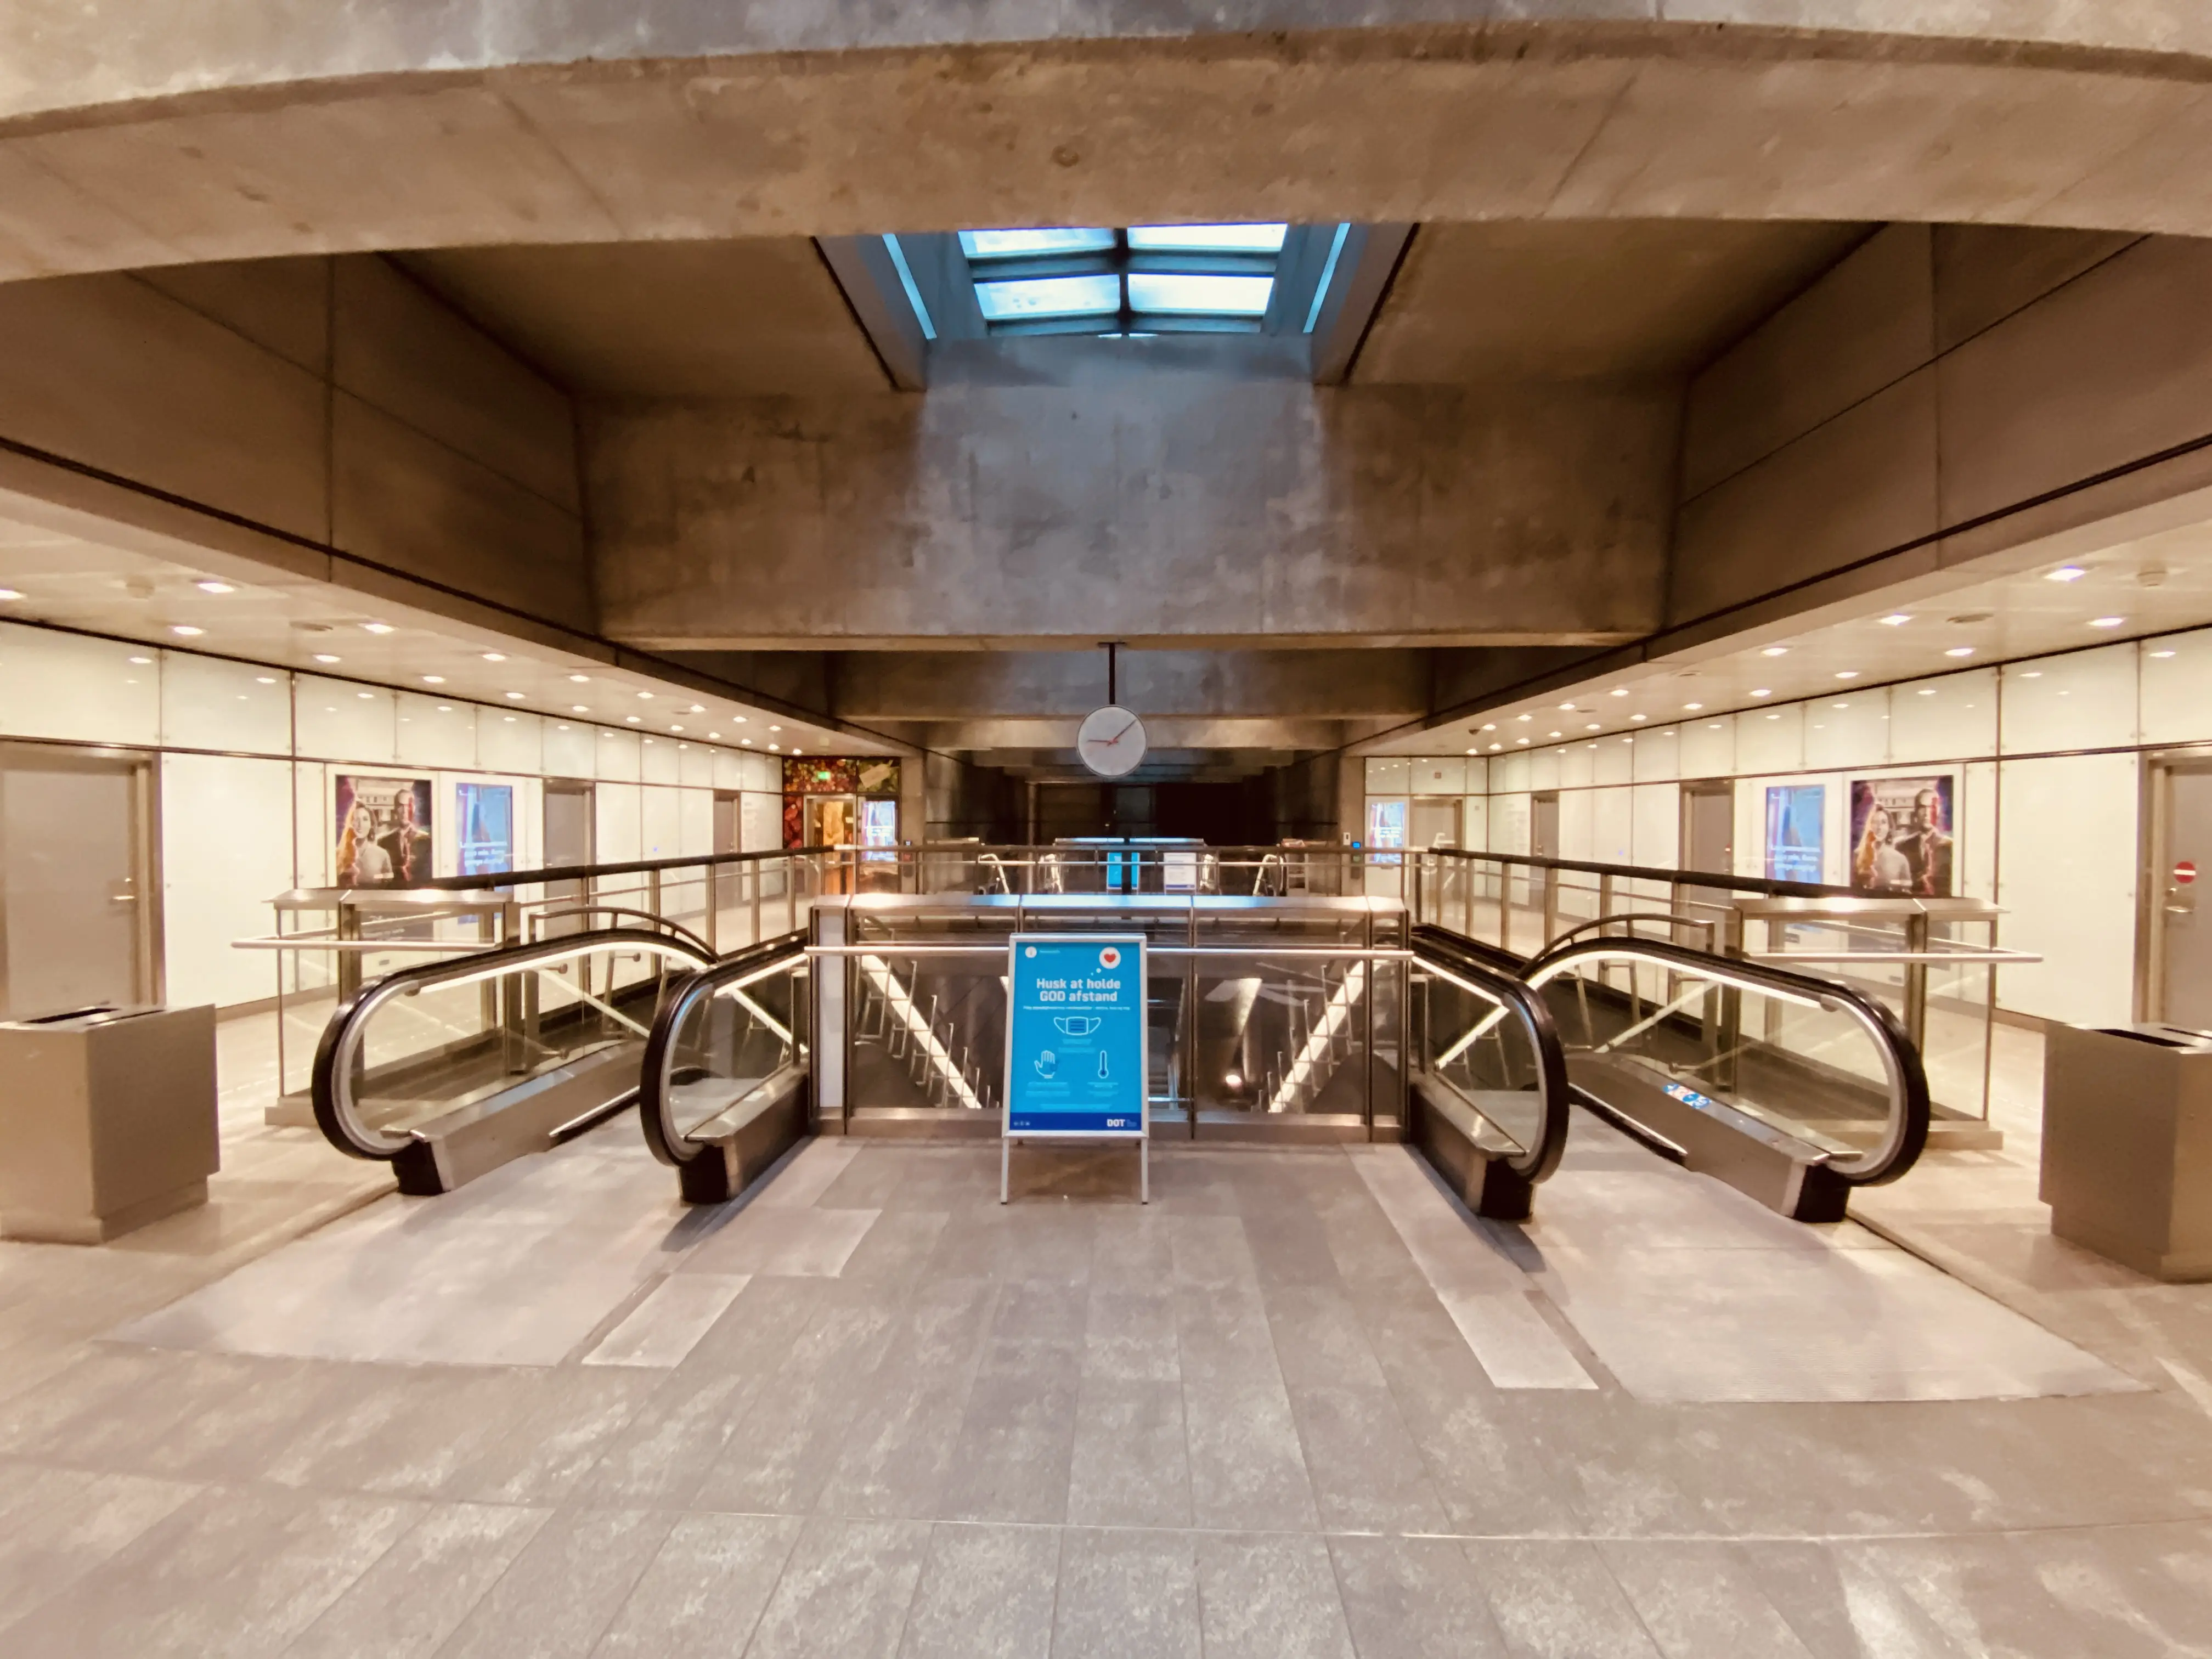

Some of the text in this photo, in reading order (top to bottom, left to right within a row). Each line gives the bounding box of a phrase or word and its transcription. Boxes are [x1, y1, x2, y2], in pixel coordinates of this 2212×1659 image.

[1036, 978, 1121, 989] Husk at holde
[1040, 990, 1118, 1002] GOD afstand
[1107, 1119, 1125, 1127] DOT
